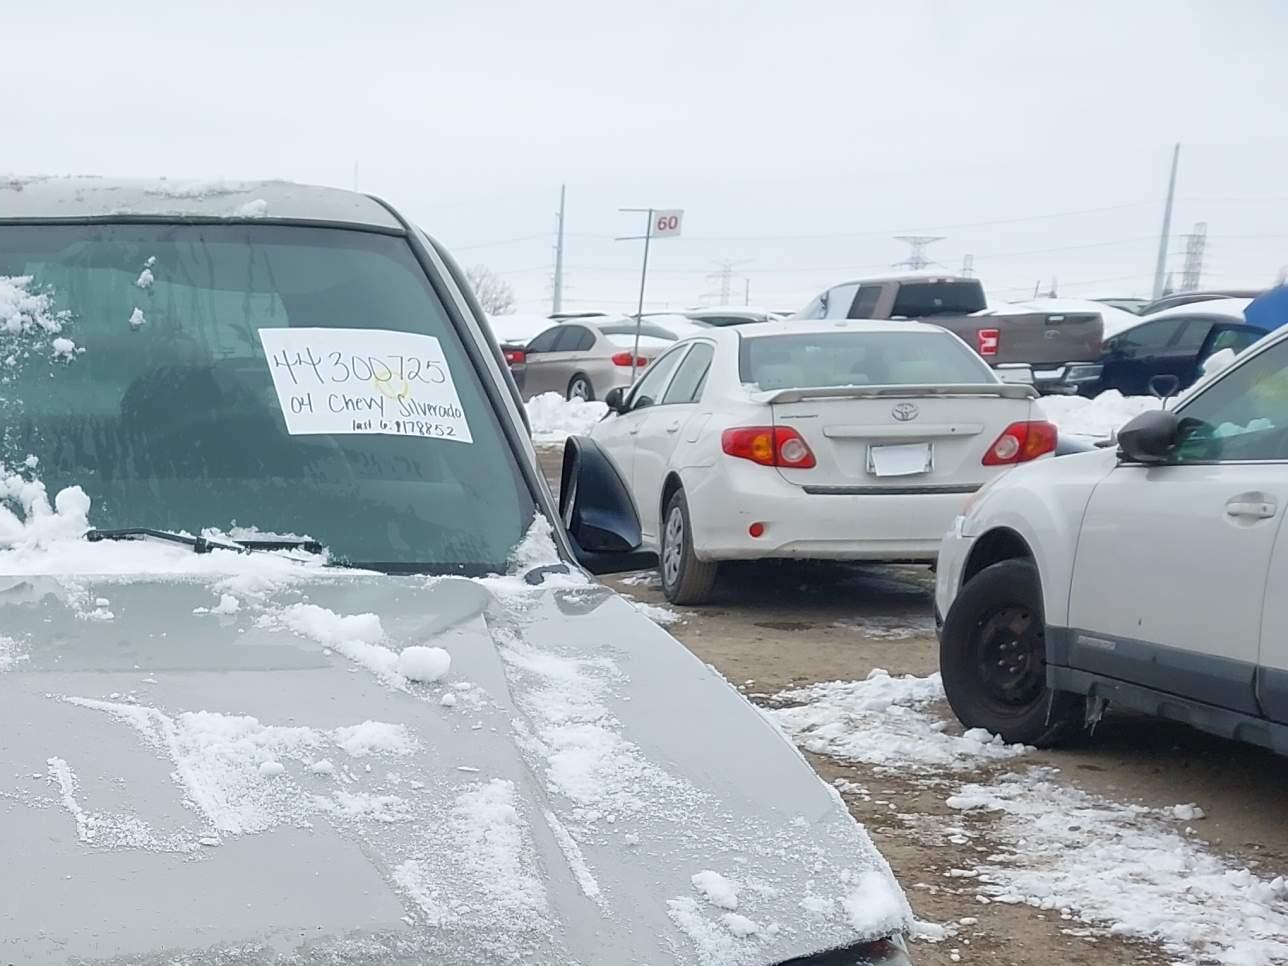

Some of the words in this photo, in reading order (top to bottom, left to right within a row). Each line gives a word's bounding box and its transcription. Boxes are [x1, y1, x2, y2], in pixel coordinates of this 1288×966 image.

[657, 215, 678, 231] 60
[273, 347, 446, 385] 44300725
[290, 393, 314, 414] 04
[328, 393, 385, 417] Chevy
[398, 393, 462, 419] Silverado
[352, 419, 372, 431] last
